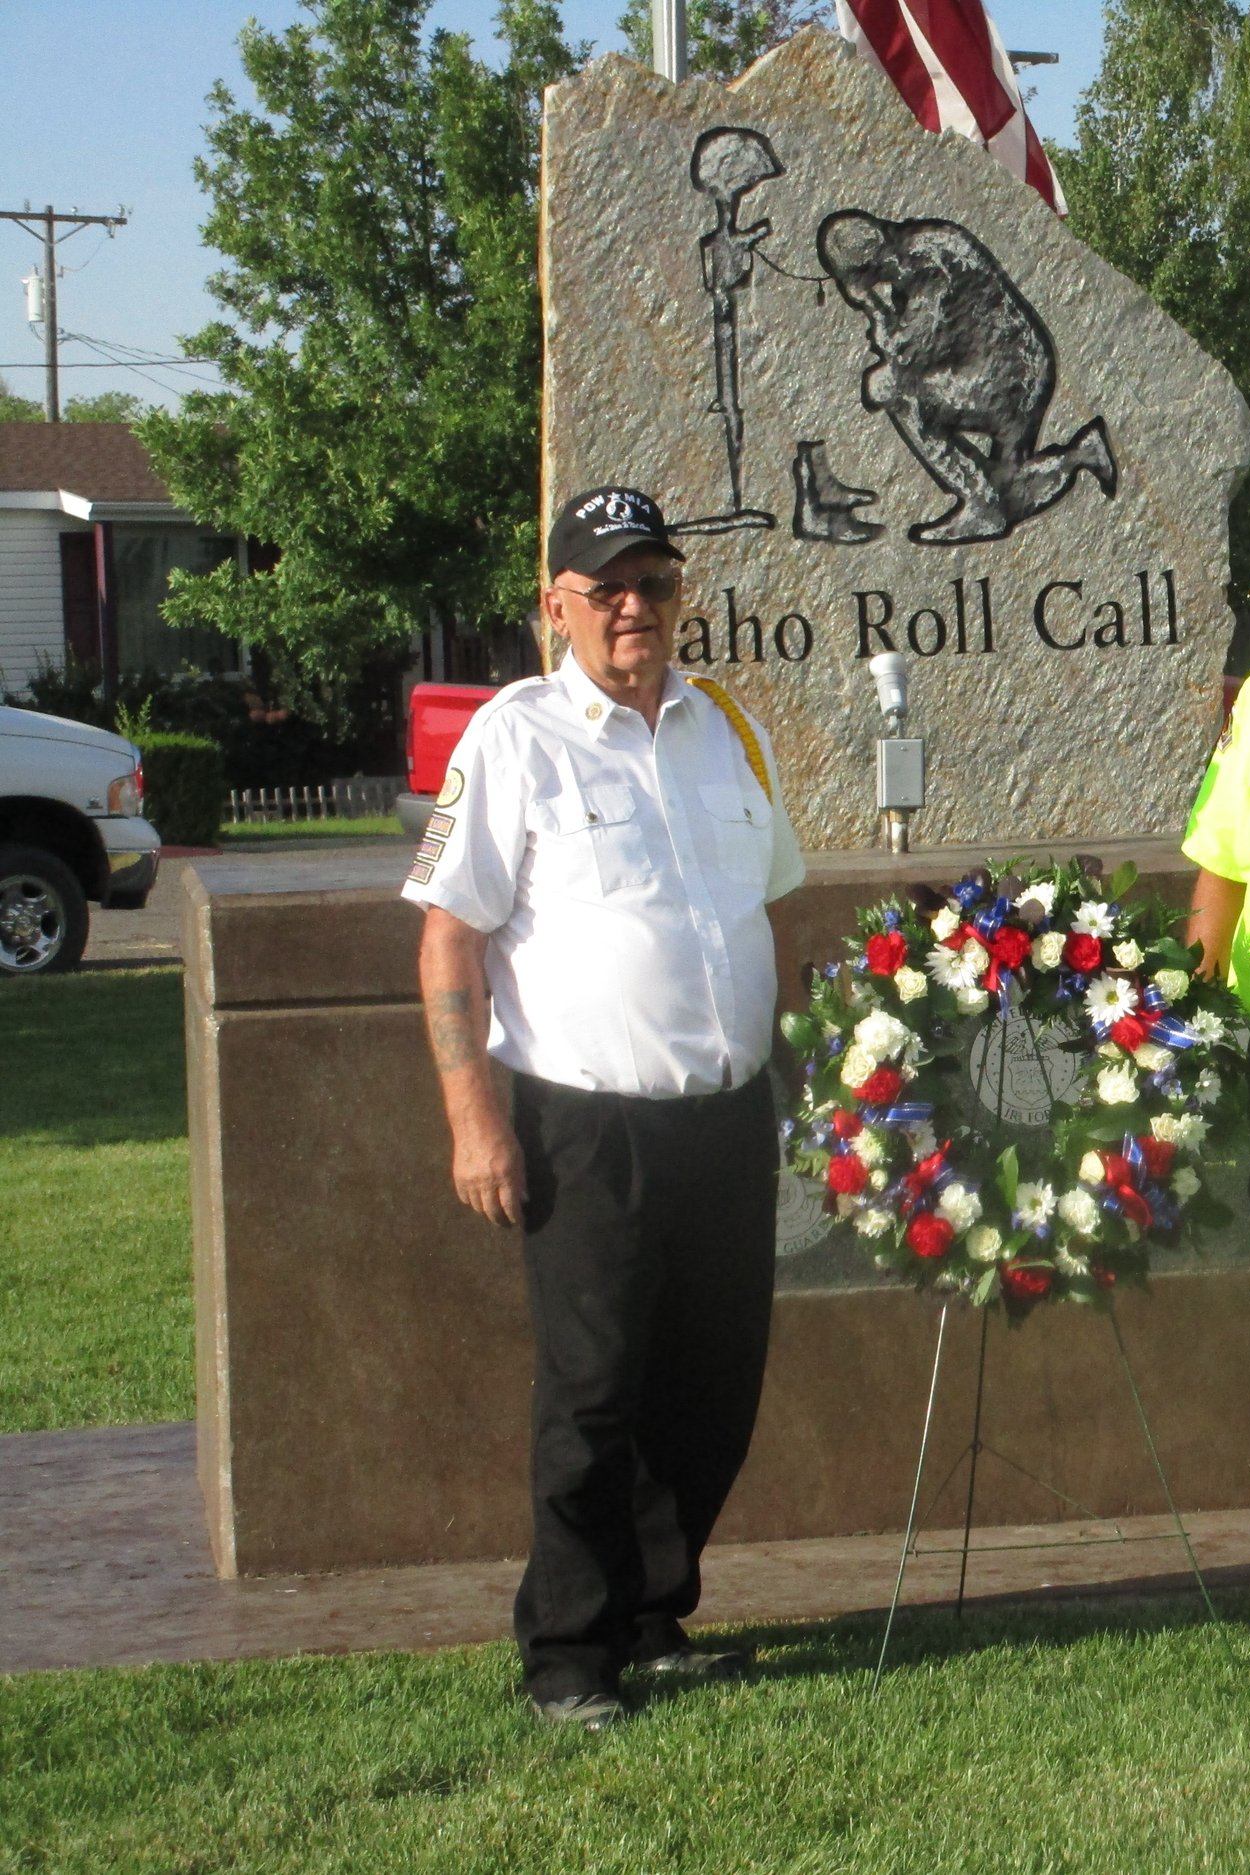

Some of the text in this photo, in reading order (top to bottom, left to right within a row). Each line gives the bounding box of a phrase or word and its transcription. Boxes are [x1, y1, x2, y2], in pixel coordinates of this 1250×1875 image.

[575, 493, 650, 519] POW MIA
[678, 568, 1181, 665] aho Roll Call
